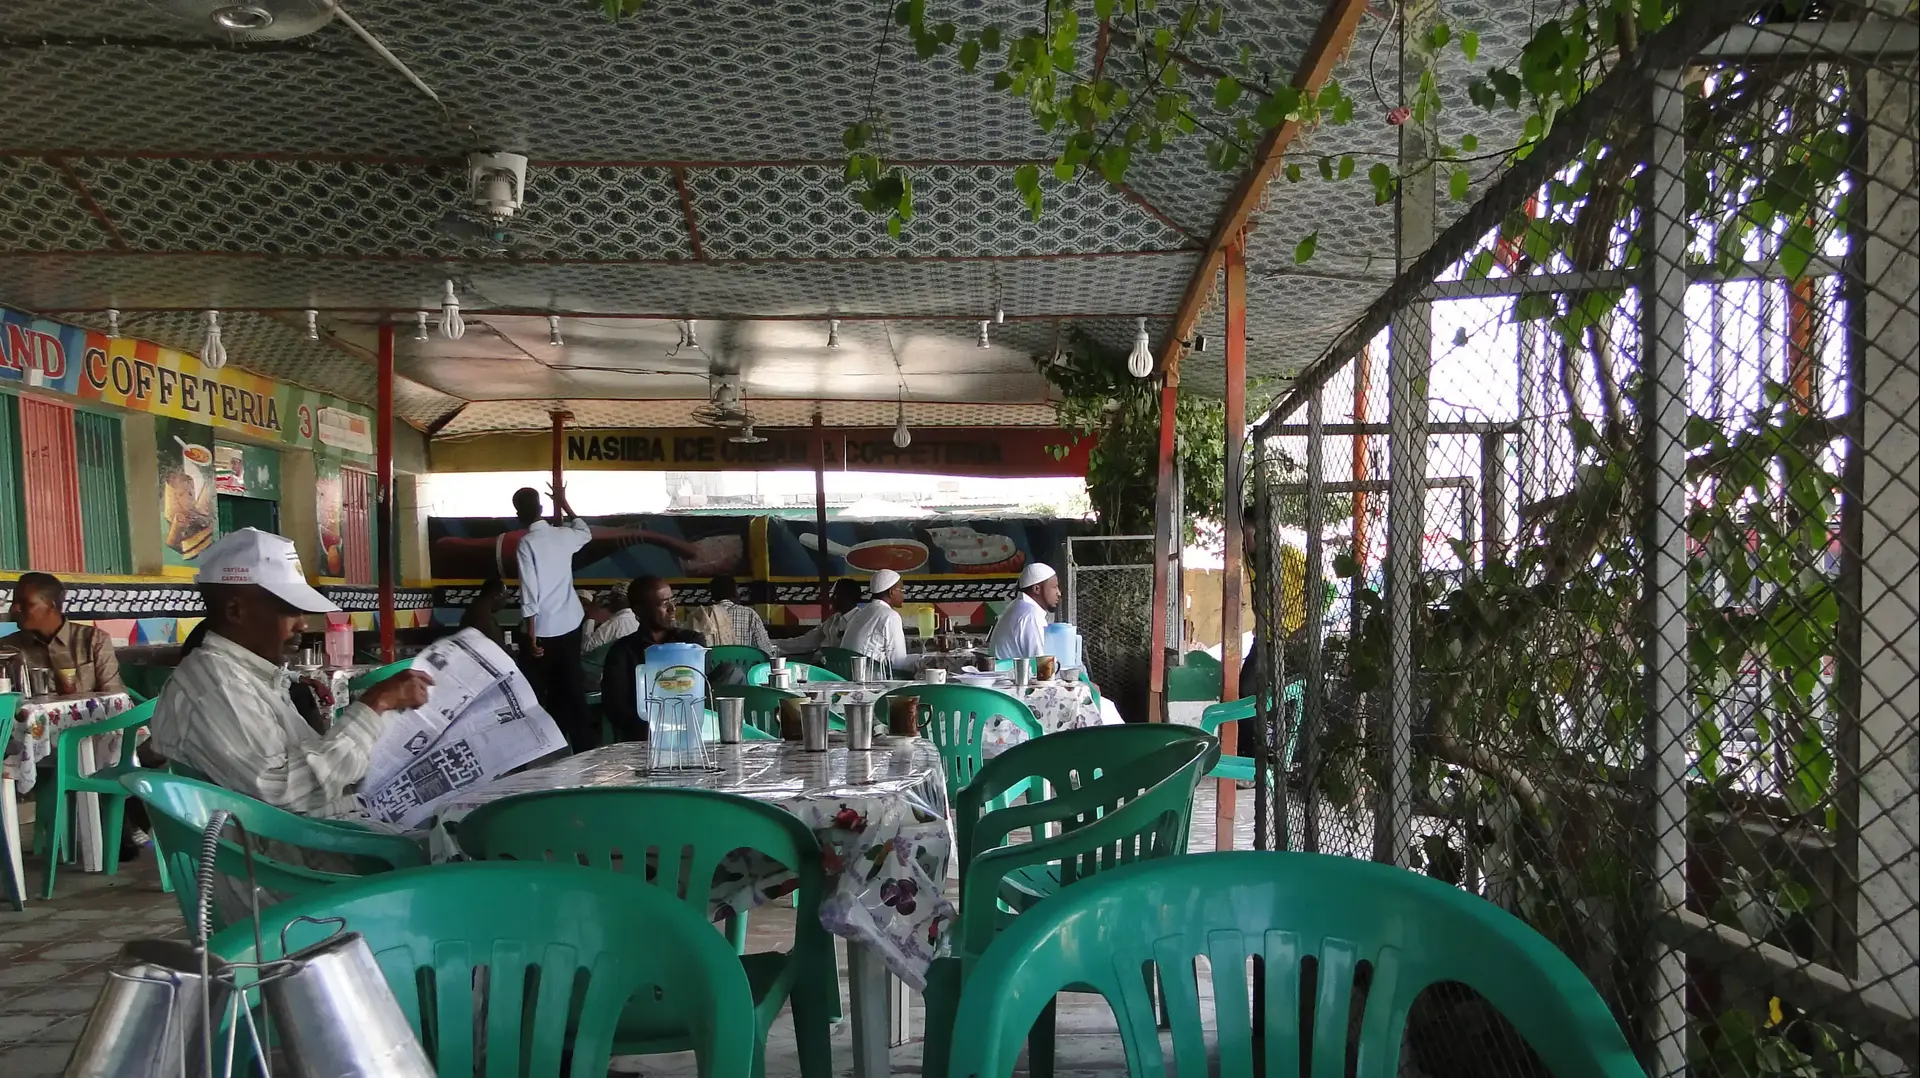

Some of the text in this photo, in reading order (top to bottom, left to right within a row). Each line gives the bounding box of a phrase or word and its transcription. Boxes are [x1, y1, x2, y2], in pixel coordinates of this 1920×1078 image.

[85, 348, 282, 432] COFFETERIA
[297, 405, 312, 439] 3
[568, 436, 665, 463] NASIIBA
[673, 437, 715, 463] ICE
